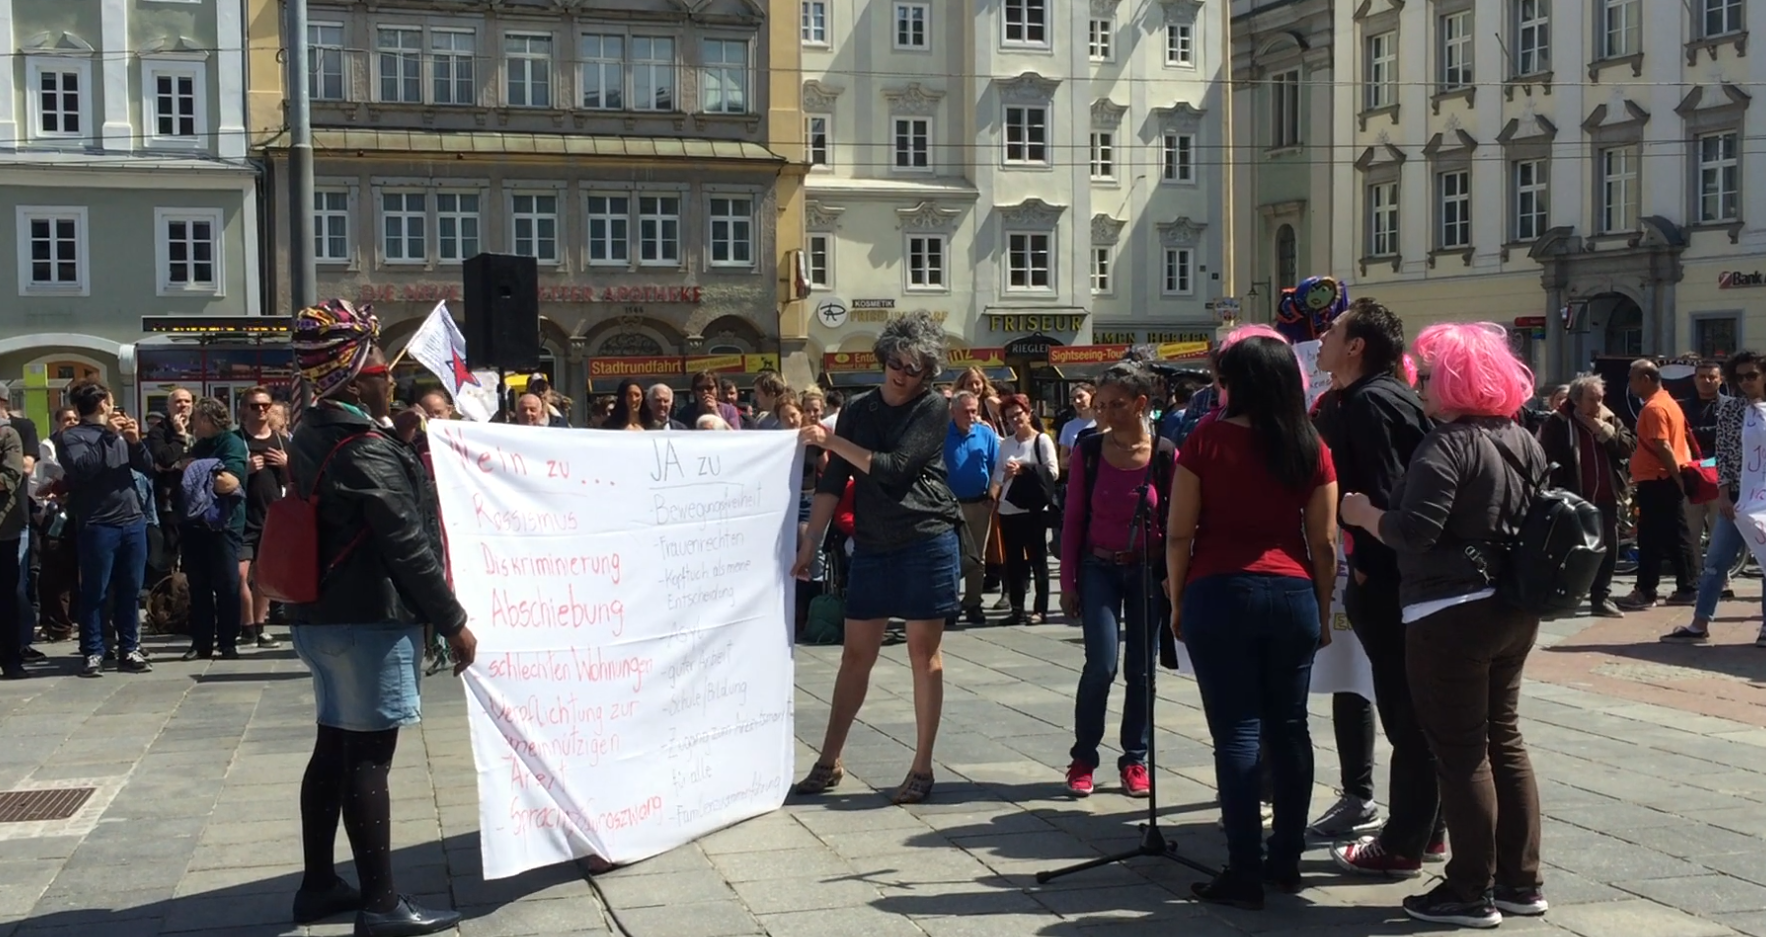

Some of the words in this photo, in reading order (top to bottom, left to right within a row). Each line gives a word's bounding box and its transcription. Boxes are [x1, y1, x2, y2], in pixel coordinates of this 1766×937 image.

[1733, 270, 1763, 286] Bank
[361, 284, 395, 300] DIE
[604, 285, 701, 302] APOTHEKE
[989, 315, 1083, 331] FRISEUR
[1092, 333, 1136, 345] AMEN
[947, 349, 974, 363] inz
[592, 359, 682, 375] Stadtrundfahrt
[444, 427, 527, 475] Nein
[547, 460, 570, 478] zu
[650, 439, 685, 482] JA
[483, 542, 620, 584] Diskriminierung
[491, 584, 626, 638] Abschiebung
[488, 650, 571, 682] schlechten
[571, 645, 653, 693] Wohnungen
[610, 700, 640, 720] zur
[502, 726, 620, 767] meinnützigen
